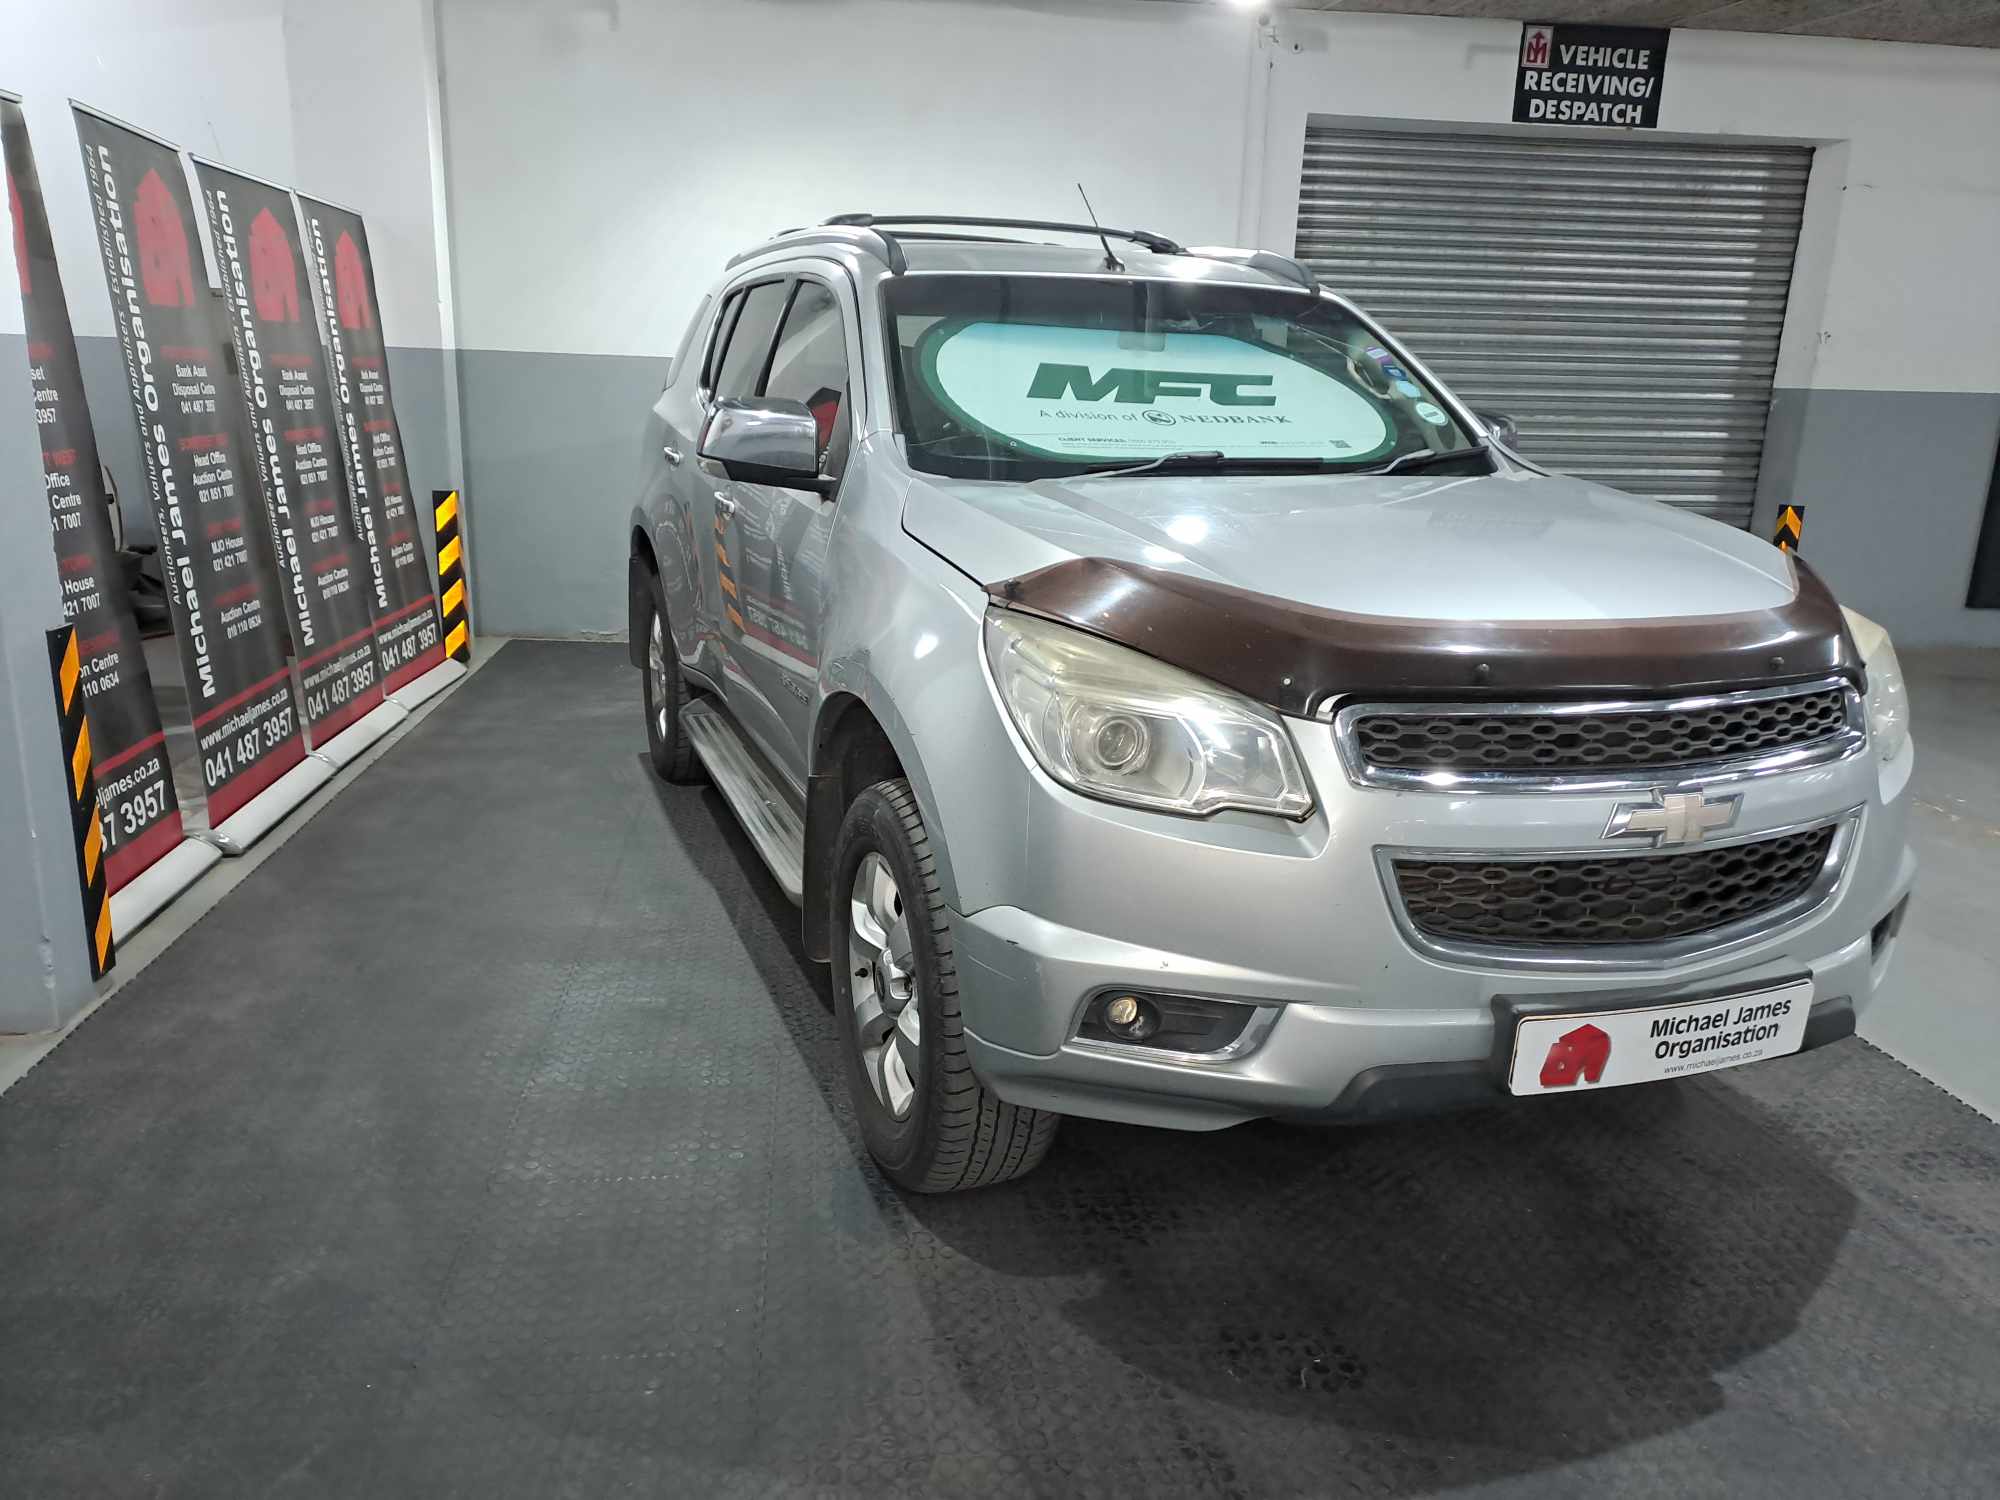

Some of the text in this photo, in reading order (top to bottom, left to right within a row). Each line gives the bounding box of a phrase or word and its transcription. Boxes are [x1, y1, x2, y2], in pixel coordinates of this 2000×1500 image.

[1560, 44, 1650, 70] VEHICLE
[1524, 70, 1655, 98] RECEIVING/
[1529, 99, 1642, 125] DESPATCH
[311, 218, 350, 404] Organisation
[118, 311, 142, 400] Appraisers
[34, 388, 59, 402] entre
[1026, 362, 1276, 406] MFC
[98, 145, 216, 698] Michael James Organisation
[135, 403, 148, 436] and
[217, 190, 315, 647] Michael James Organisation
[1039, 408, 1138, 422] A division of
[1179, 414, 1293, 425] NEDBANK
[143, 442, 161, 501] Valuers
[345, 412, 368, 499] James
[52, 494, 81, 510] Centre
[61, 512, 81, 530] 7007
[157, 508, 181, 605] Auctioneers,
[360, 507, 388, 608] Michael
[64, 577, 95, 594] House
[81, 593, 100, 612] 7007
[91, 651, 119, 673] Centre
[382, 623, 437, 671] 041 487 3957
[100, 671, 120, 692] 0634
[307, 661, 374, 720] 041 487 3957
[205, 706, 292, 786] 041 487 3957
[120, 779, 166, 834] 3957
[1650, 999, 1791, 1038] Michael James
[1655, 1023, 1779, 1059] Organisation
